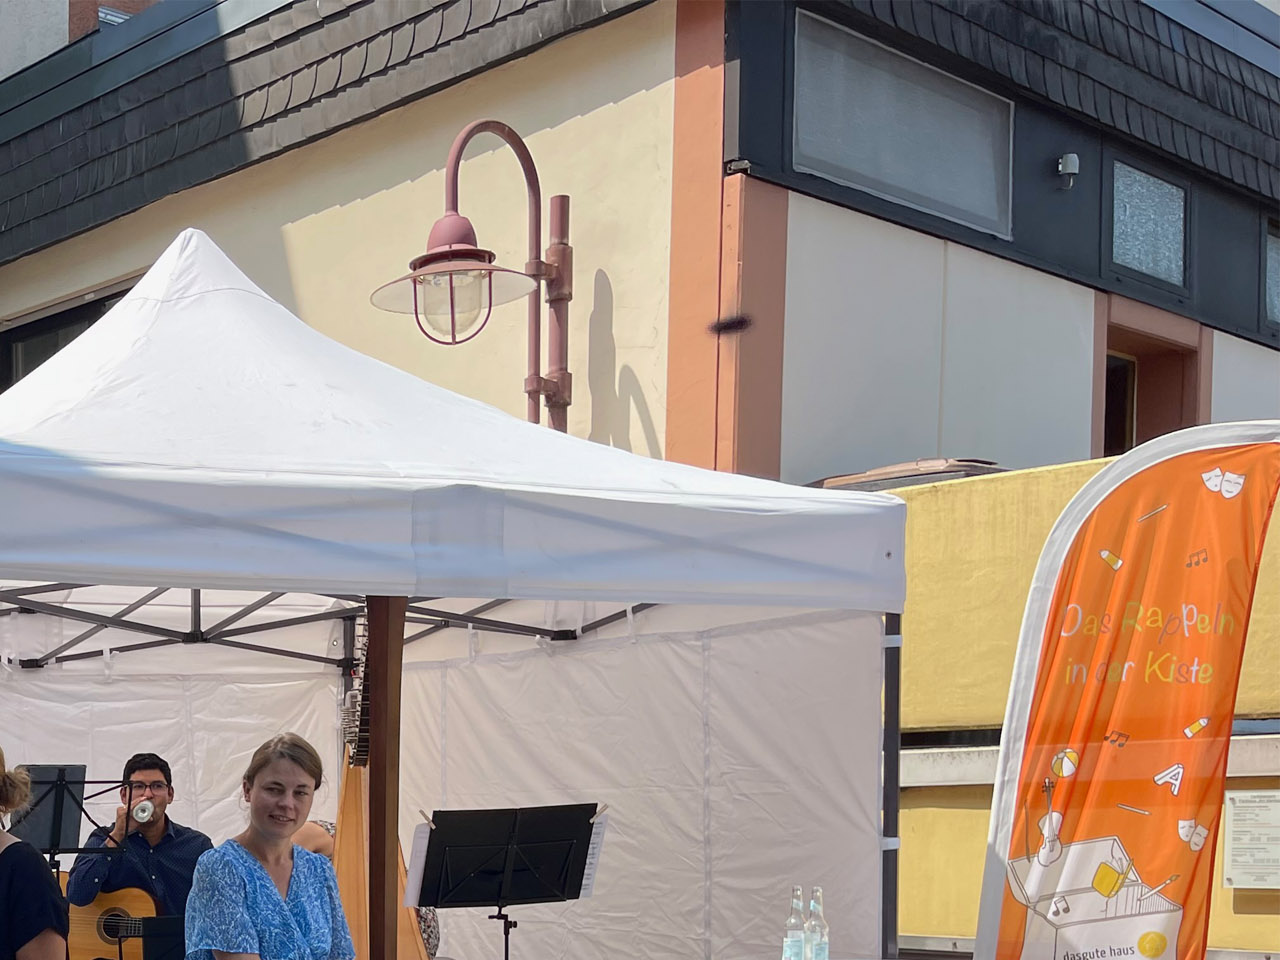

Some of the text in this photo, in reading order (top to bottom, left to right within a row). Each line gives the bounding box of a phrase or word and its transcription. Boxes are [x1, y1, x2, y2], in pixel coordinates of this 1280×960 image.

[1060, 601, 1234, 644] Das Rappeln
[1065, 657, 1087, 685] in
[1144, 651, 1214, 685] Kiste
[1109, 945, 1135, 958] haus
